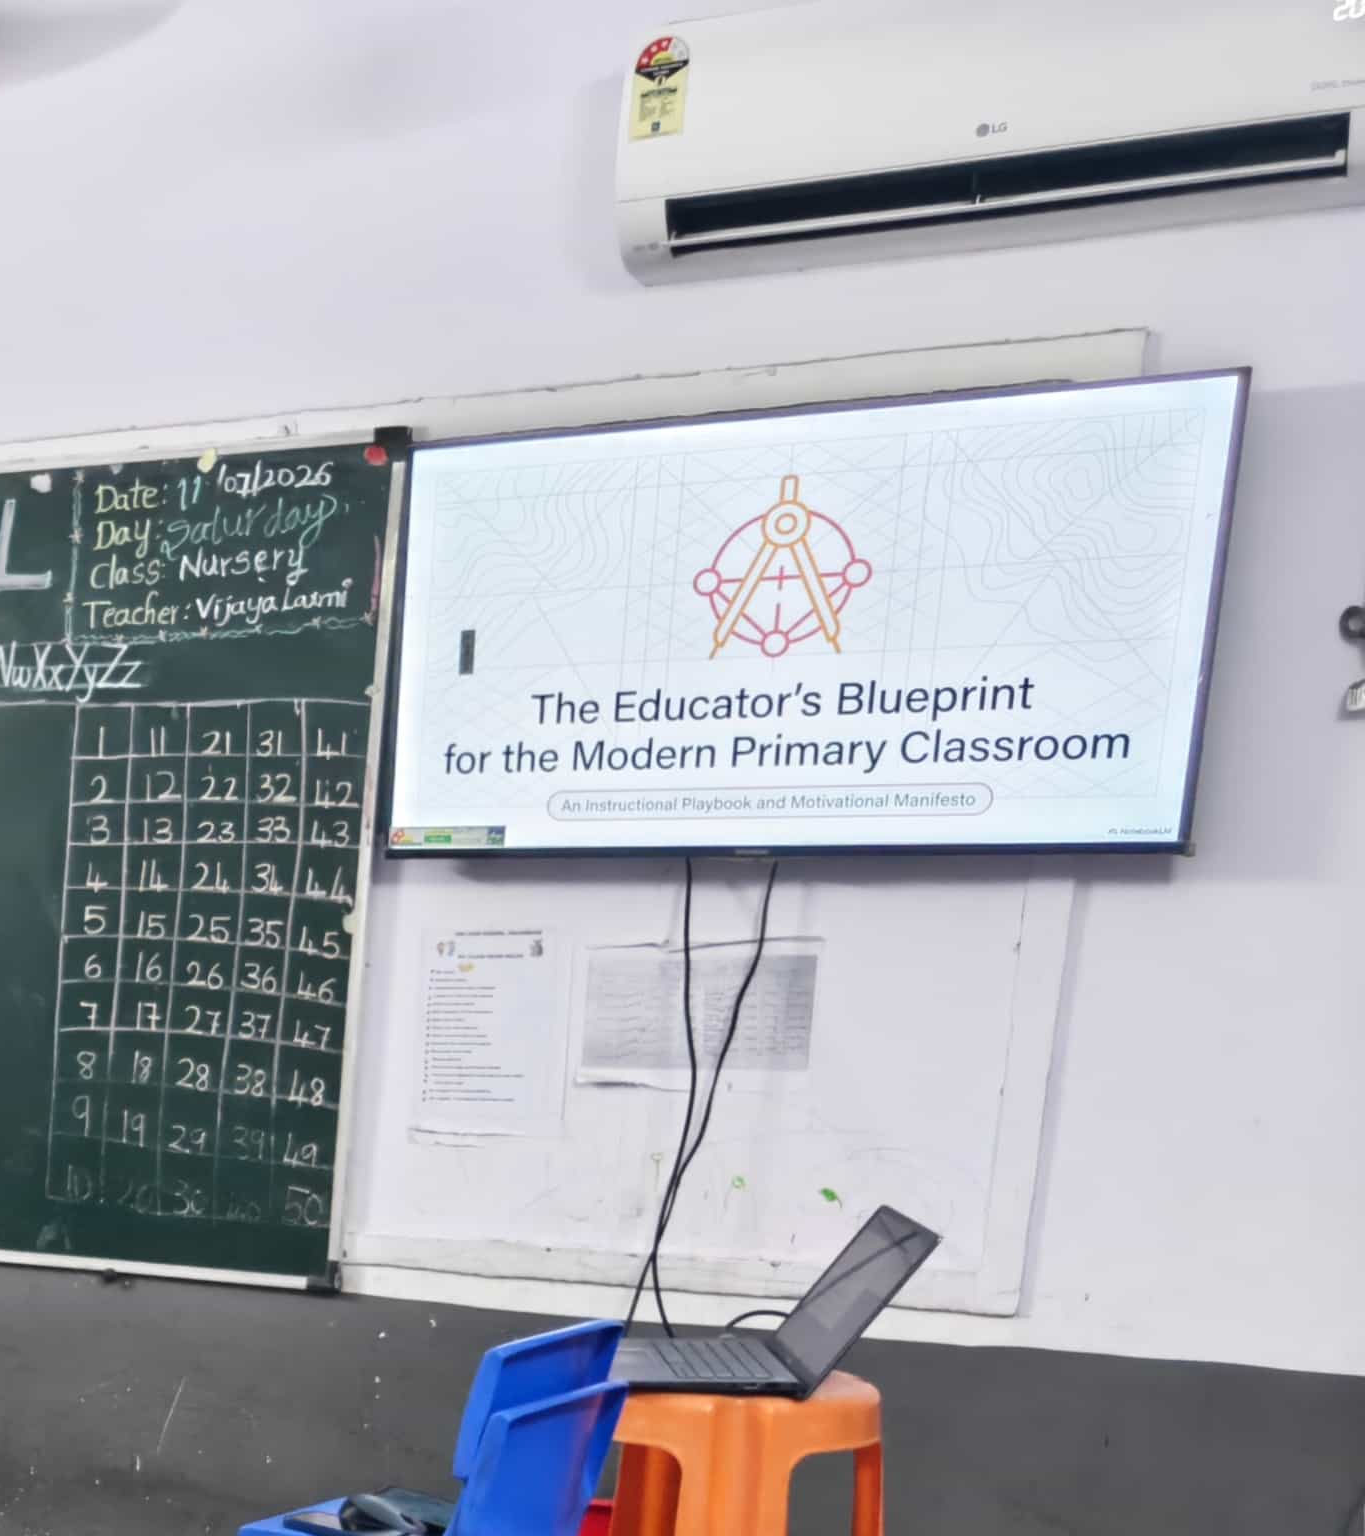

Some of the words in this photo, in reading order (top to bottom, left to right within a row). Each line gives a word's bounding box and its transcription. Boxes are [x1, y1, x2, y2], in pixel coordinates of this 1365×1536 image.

[991, 121, 1008, 134] LG
[94, 475, 168, 514] Date:
[93, 518, 163, 559] Day:
[179, 547, 308, 586] Nursery
[82, 591, 190, 629] Teacher:
[531, 691, 600, 725] The
[837, 675, 1035, 721] Blueprint
[98, 726, 105, 757] 1
[149, 726, 166, 756] 11
[201, 731, 231, 755] 21
[256, 729, 283, 756] 31
[316, 728, 347, 760] 41
[444, 743, 492, 775] for
[502, 740, 559, 774] the
[572, 737, 716, 772] Modern
[731, 733, 887, 774] Primary
[900, 728, 1130, 764] Classroom
[90, 775, 114, 803] 2
[146, 771, 181, 802] 12
[199, 776, 239, 800] 22
[258, 774, 297, 803] 32
[314, 779, 359, 808] 42
[561, 799, 581, 812] An
[585, 798, 677, 813] Instructional
[682, 796, 751, 814] Playbook
[756, 796, 786, 809] and
[791, 794, 889, 809] Motivational
[894, 792, 976, 808] Manifesto
[87, 815, 111, 845] 3
[143, 817, 174, 843] 13
[196, 821, 236, 843] 23
[255, 816, 291, 843] 33
[311, 820, 350, 849] 43
[85, 861, 109, 893] 4
[139, 859, 169, 892] 14
[191, 862, 231, 894] 24
[252, 863, 283, 896] 34
[305, 866, 354, 906] 44
[83, 905, 109, 936] 5
[137, 911, 167, 938] 15
[187, 914, 231, 945] 25
[246, 918, 284, 949] 35
[298, 926, 342, 960] 45
[84, 953, 103, 980] 6
[135, 951, 163, 984] 16
[185, 960, 224, 990] 26
[240, 962, 278, 994] 36
[296, 971, 337, 1004] 46
[79, 1001, 98, 1029] 7
[137, 1000, 161, 1031] 17
[184, 1005, 222, 1036] 27
[239, 1011, 272, 1040] 37
[293, 1019, 332, 1050] 47
[76, 1051, 97, 1081] 8
[132, 1050, 153, 1085] 18
[175, 1058, 210, 1091] 28
[234, 1063, 266, 1097] 38
[287, 1069, 327, 1106] 48
[71, 1095, 90, 1137] 9
[122, 1109, 146, 1149] 19
[168, 1124, 208, 1155] 29
[282, 1132, 319, 1167] 49
[284, 1185, 324, 1226] 50
